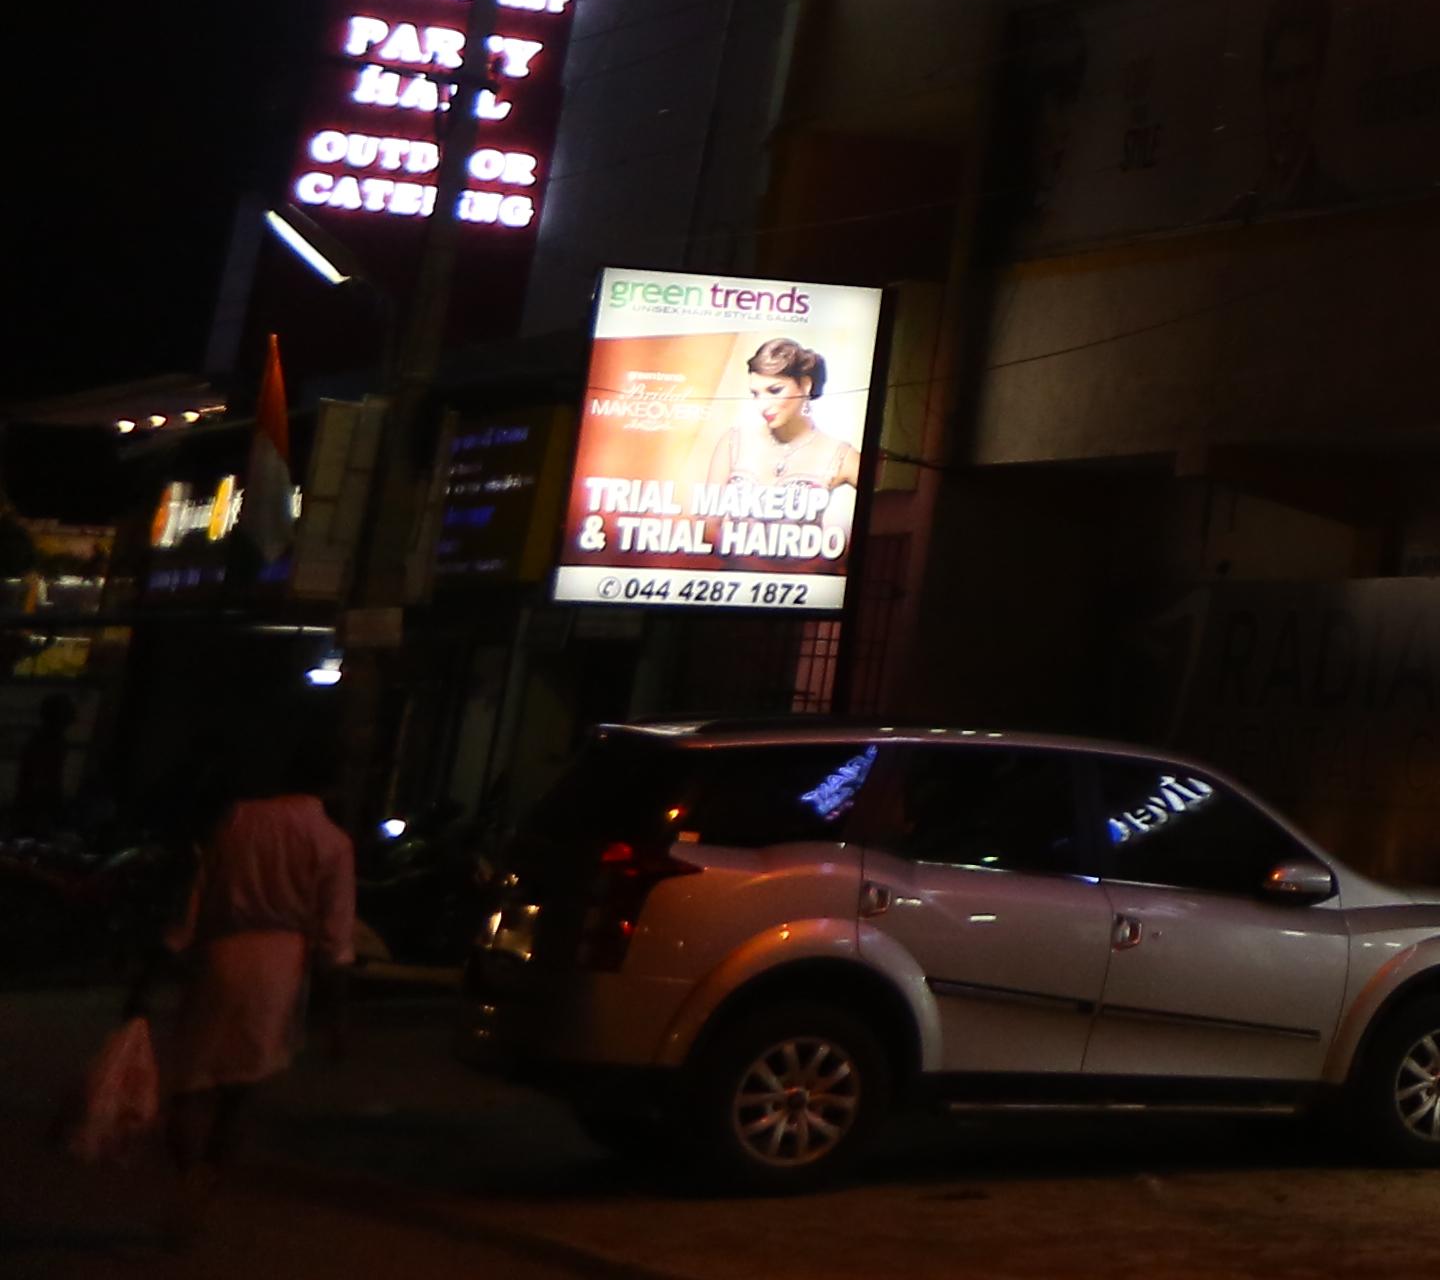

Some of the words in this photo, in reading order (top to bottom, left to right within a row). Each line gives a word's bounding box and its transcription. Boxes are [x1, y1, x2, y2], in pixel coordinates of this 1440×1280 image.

[343, 15, 544, 78] PARY
[308, 130, 538, 186] OUTDOR
[609, 280, 704, 309] green
[710, 283, 810, 315] trends
[586, 476, 683, 516] TRIAL
[690, 481, 830, 522] MAKEUP
[579, 515, 606, 552] &
[616, 517, 713, 557] TRIAL
[720, 522, 848, 562] HAIRDO
[623, 577, 670, 600] 044
[678, 578, 741, 604] 4287
[750, 581, 809, 606] 1872
